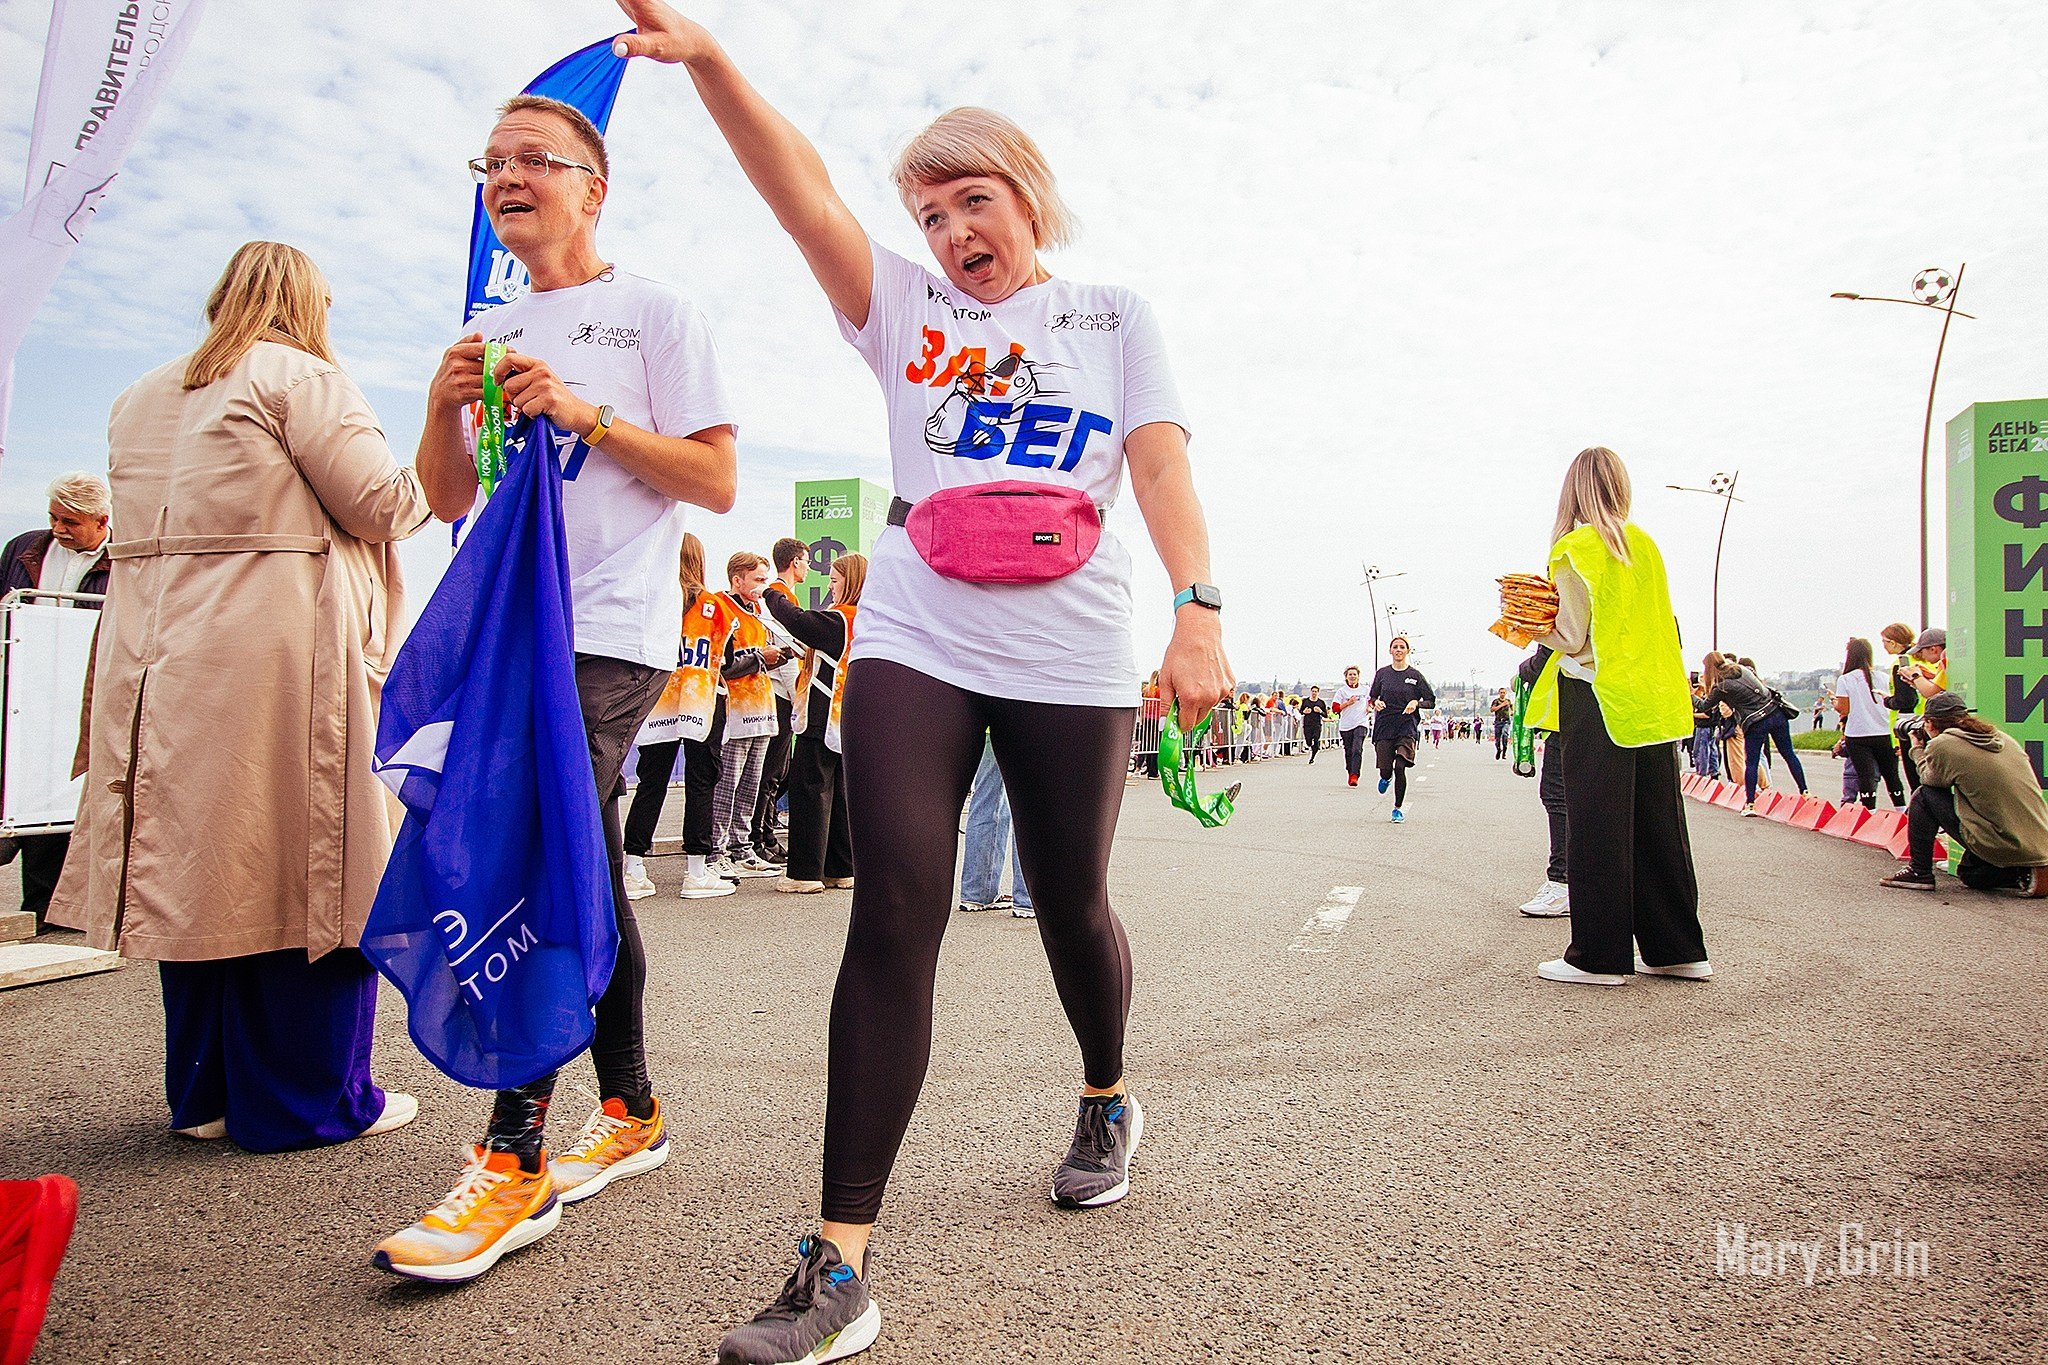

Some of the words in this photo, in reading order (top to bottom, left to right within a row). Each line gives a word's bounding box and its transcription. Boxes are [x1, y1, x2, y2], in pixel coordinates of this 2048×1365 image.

[75, 0, 140, 151] ПРАВИТЕЛЬ
[605, 327, 641, 339] АТОМ
[1079, 320, 1120, 332] СПОР
[953, 401, 1114, 474] БЕГ
[1988, 421, 2039, 438] ДЕНЬ
[1988, 438, 2028, 453] БЕГА
[481, 448, 492, 477] КРОСС
[801, 496, 830, 509] ДЕНЬ
[801, 509, 824, 520] БЕГА
[824, 507, 854, 520] 2023
[459, 923, 539, 1005] ТОМ
